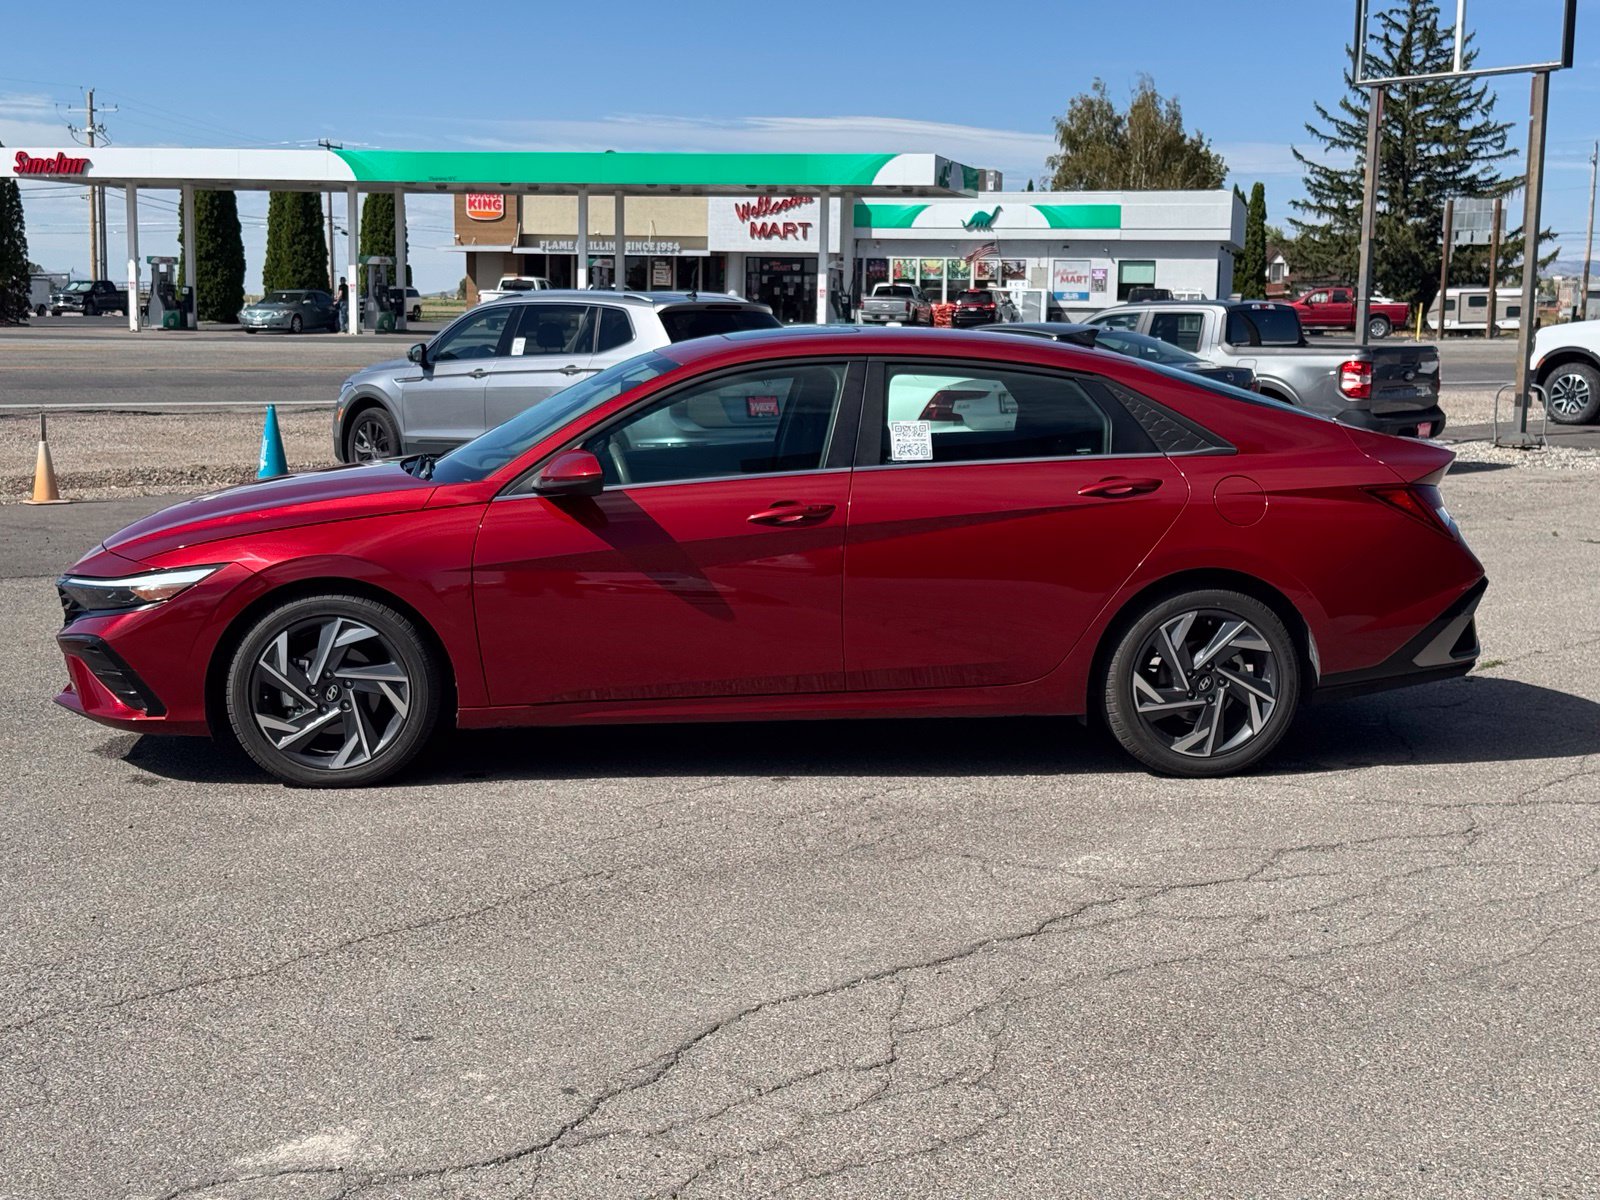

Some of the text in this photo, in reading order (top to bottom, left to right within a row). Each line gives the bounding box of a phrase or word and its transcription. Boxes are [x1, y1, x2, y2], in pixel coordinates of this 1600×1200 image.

[13, 151, 90, 174] Sinclair
[468, 199, 502, 210] KING
[750, 221, 813, 240] MART
[540, 240, 574, 250] FLAME
[625, 241, 655, 251] SINCE
[657, 242, 680, 251] 1954
[1060, 275, 1088, 283] MART
